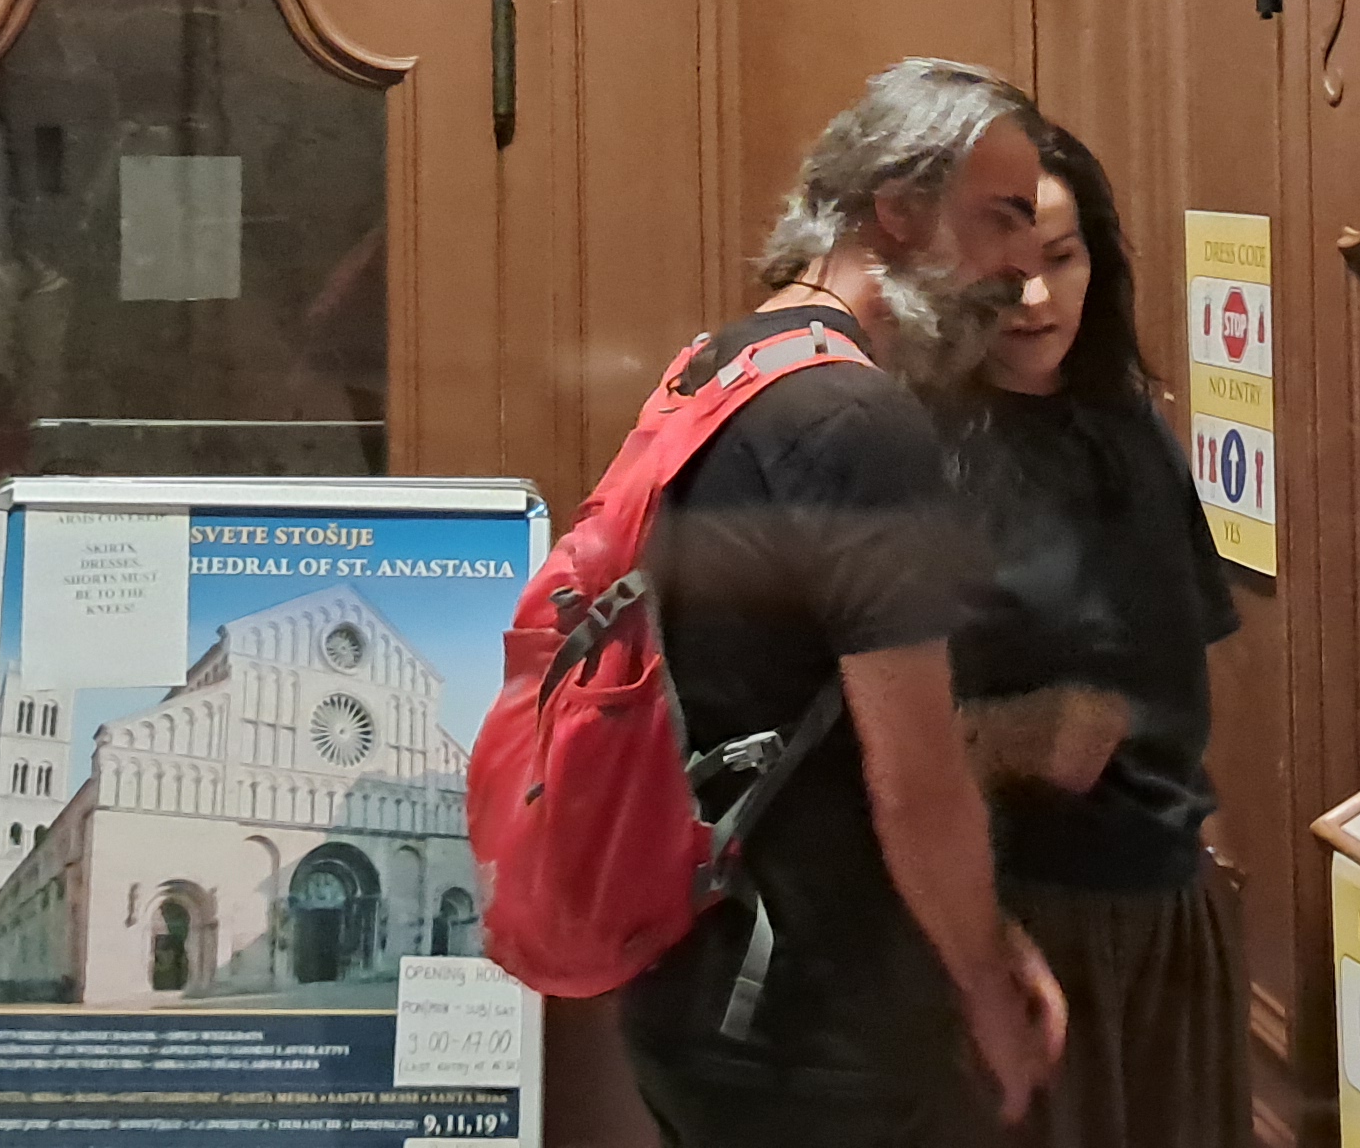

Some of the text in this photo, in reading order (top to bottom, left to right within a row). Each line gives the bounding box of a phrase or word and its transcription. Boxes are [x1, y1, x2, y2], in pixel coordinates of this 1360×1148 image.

[1204, 240, 1266, 268] DRESS CODE
[1224, 311, 1247, 339] STOP
[1208, 376, 1262, 405] NO ENTRY
[190, 522, 375, 550] SVETE STOŠIJE
[1223, 521, 1241, 545] YES
[190, 556, 515, 579] HEDRAL OF ST. ANASTASIA
